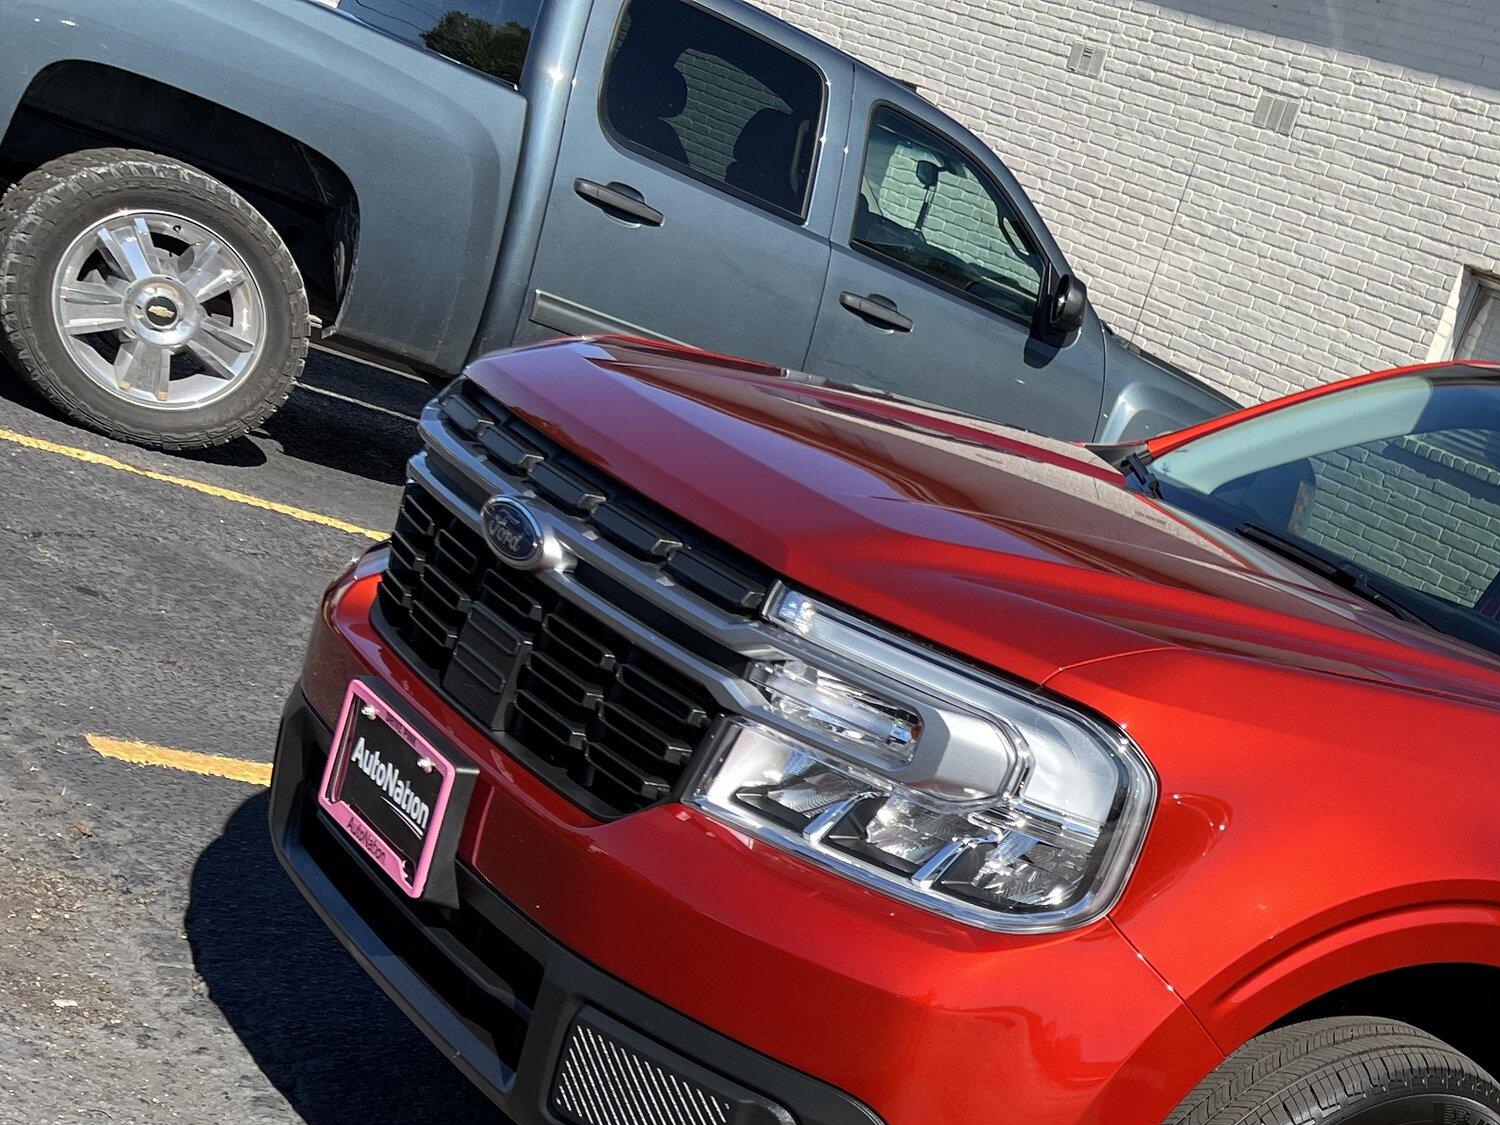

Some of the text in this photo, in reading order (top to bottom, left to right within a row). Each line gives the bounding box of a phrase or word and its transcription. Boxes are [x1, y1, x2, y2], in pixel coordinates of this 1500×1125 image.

[488, 510, 524, 553] Ford
[351, 736, 430, 829] AutoNation
[346, 816, 386, 865] AutoNation
